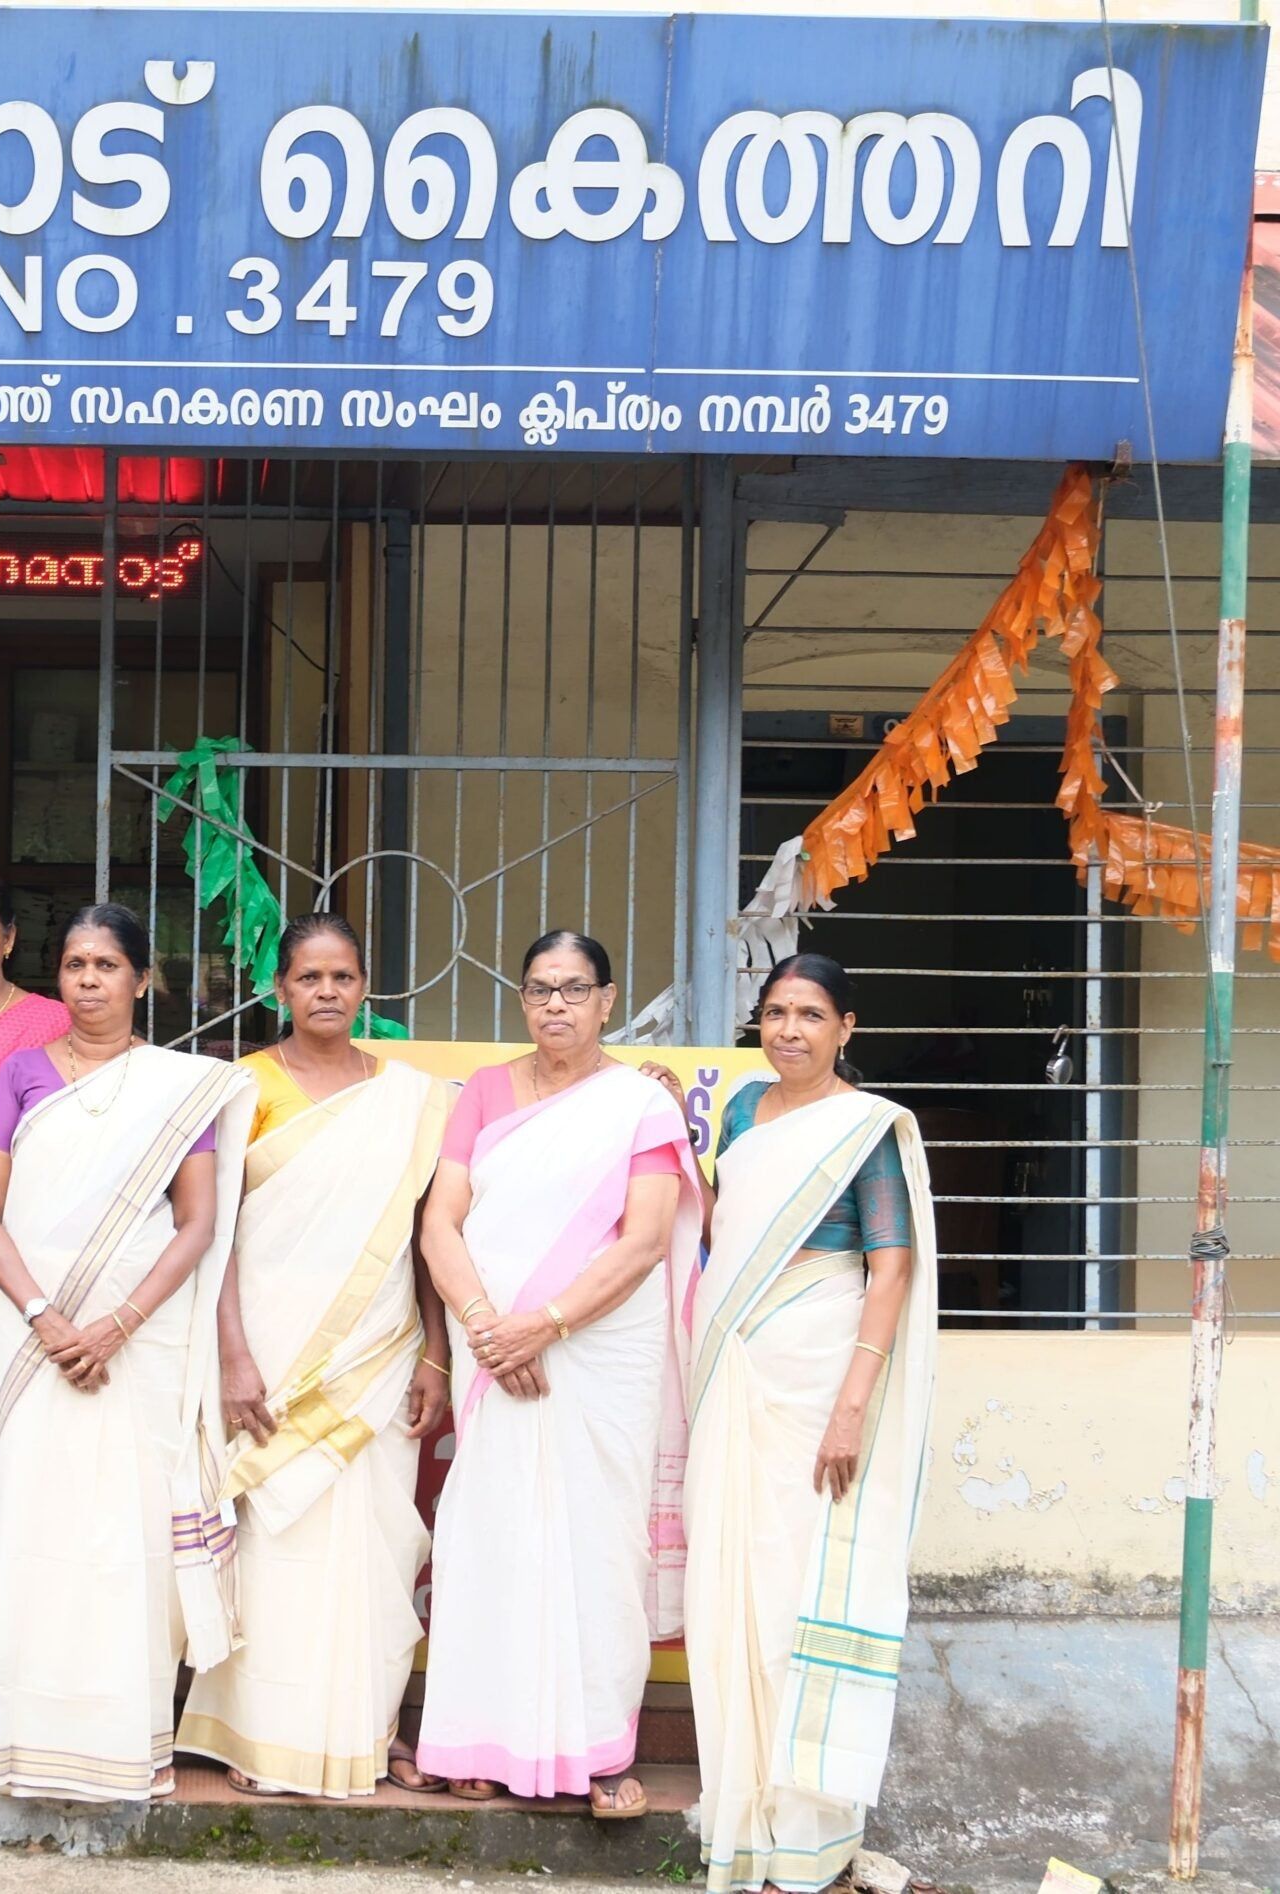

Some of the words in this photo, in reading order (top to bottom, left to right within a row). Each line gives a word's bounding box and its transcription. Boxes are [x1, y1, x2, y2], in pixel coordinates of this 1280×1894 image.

[260, 67, 1144, 248] കൈത്തറി
[226, 257, 495, 338] 3479
[69, 384, 325, 429] സഹകരണ
[341, 386, 503, 431] സംഘം
[699, 384, 831, 435] നമ്പർ
[843, 392, 950, 436] 3479
